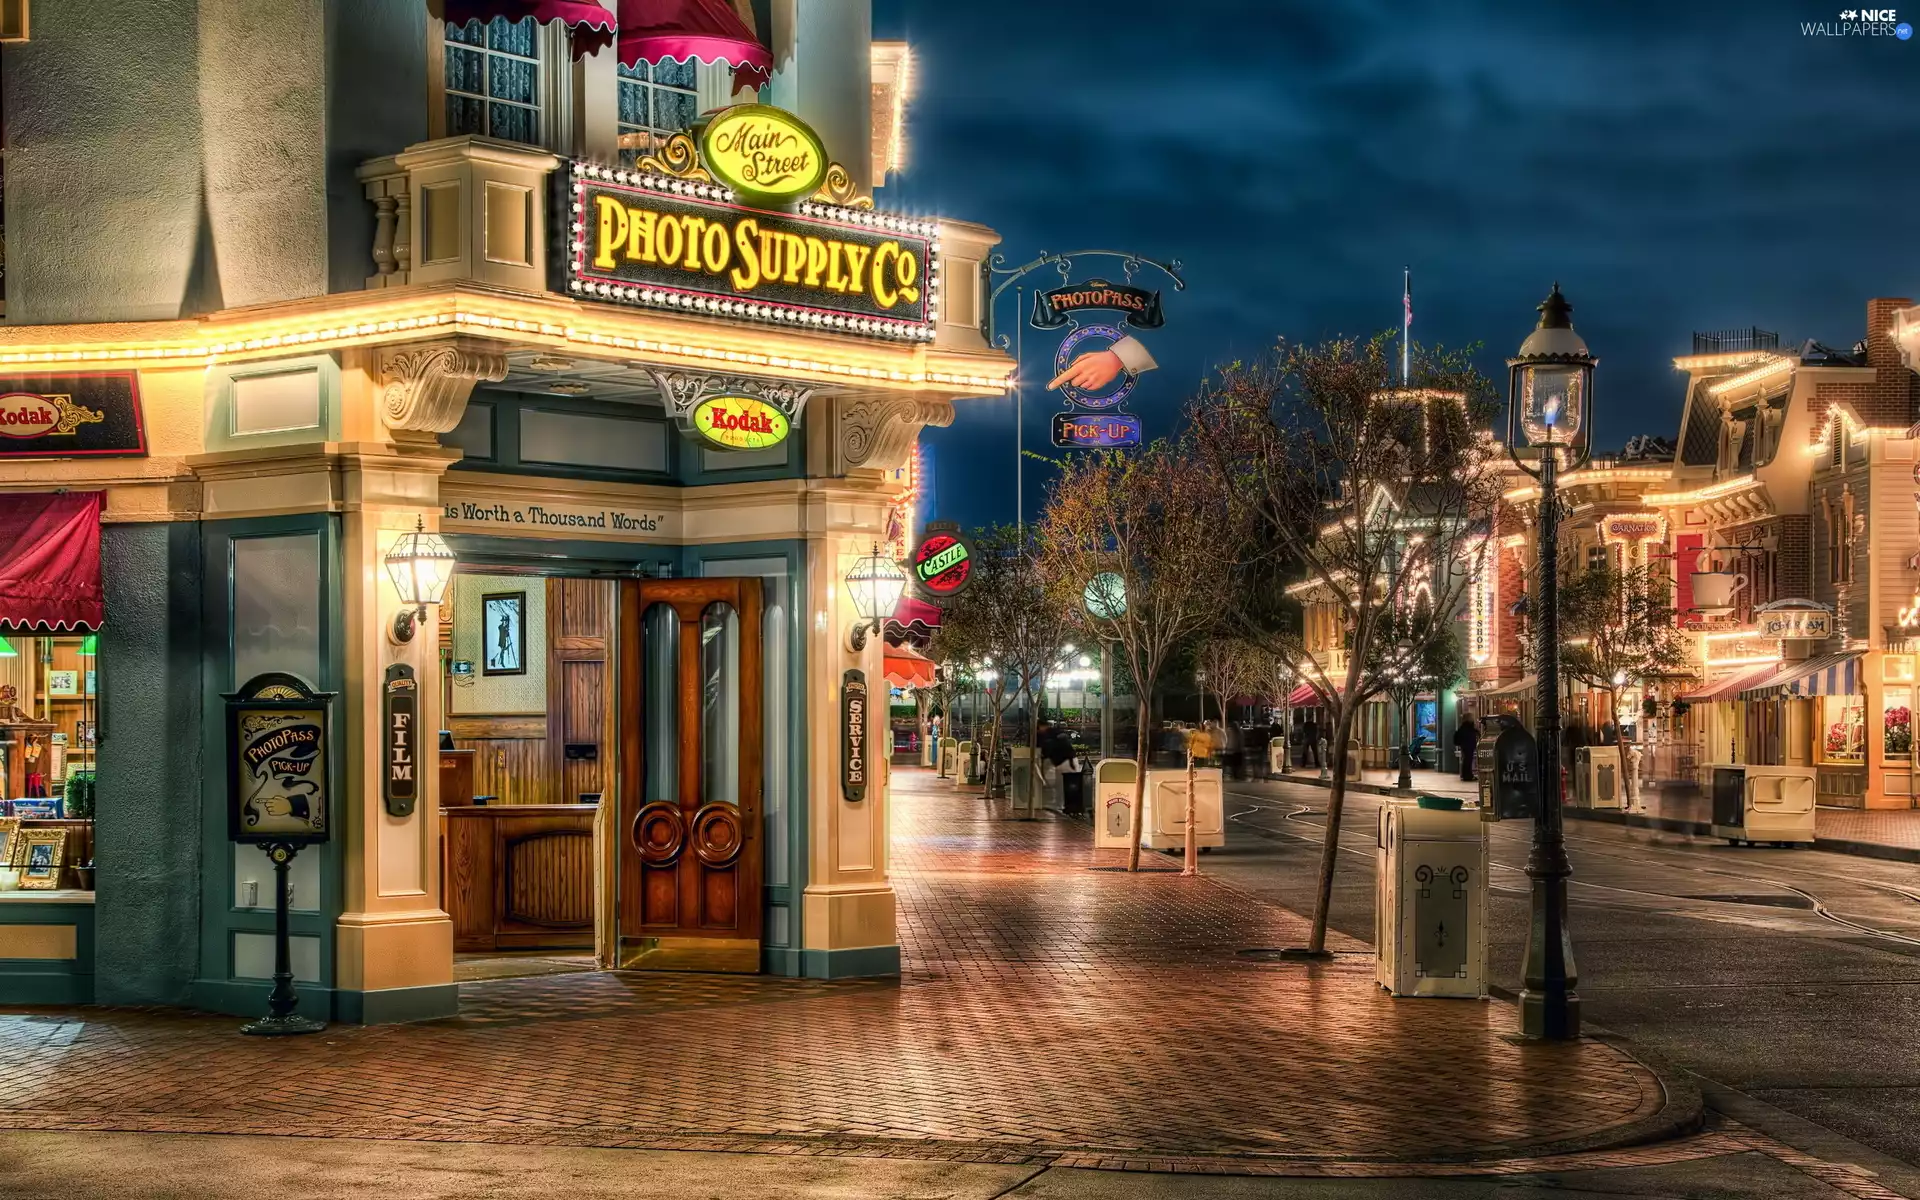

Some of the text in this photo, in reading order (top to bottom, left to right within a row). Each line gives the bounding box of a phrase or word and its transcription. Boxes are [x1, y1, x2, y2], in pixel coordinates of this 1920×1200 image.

[717, 122, 798, 158] Main
[742, 151, 810, 187] Street
[593, 195, 730, 274] PHOTO
[730, 219, 871, 293] SUPPLY
[1051, 289, 1144, 310] PHOTOPASS
[0, 407, 53, 425] Kodak
[711, 407, 773, 433] Kodak
[1062, 422, 1130, 438] PICK-UP
[444, 503, 458, 518] is
[461, 502, 510, 522] Worth
[513, 510, 525, 523] a
[528, 507, 605, 528] Thousand
[920, 545, 962, 581] CASTLE
[1476, 620, 1484, 652] SHOP
[1785, 619, 1826, 634] CRAM
[248, 729, 314, 762] PHOTOPASS
[391, 713, 412, 780] FILM
[849, 700, 863, 781] SERVICE
[271, 760, 310, 772] PICK-UP
[1503, 772, 1533, 782] MAIL
